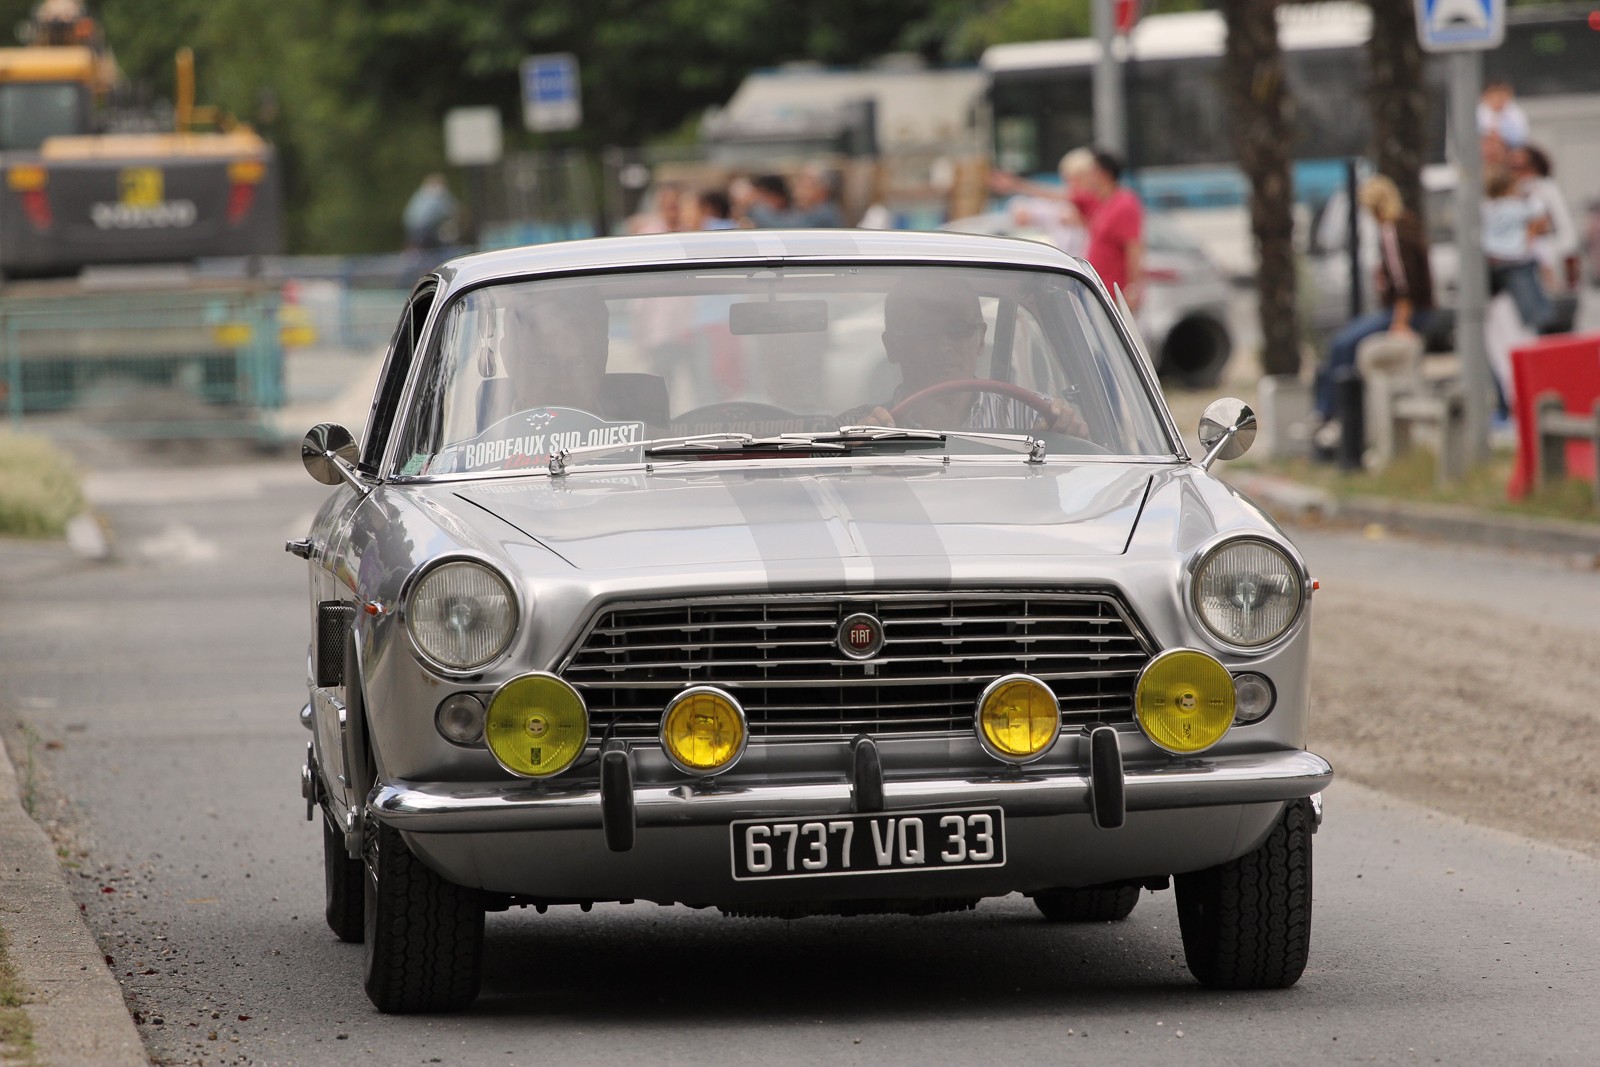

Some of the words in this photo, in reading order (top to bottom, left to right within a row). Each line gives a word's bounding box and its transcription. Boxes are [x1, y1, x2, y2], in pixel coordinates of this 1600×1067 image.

[465, 434, 545, 470] BORDEAUX
[549, 424, 639, 453] SUD-OUEST
[851, 629, 870, 643] FIAT
[745, 821, 854, 873] 6737
[870, 818, 925, 866] VQ
[940, 814, 994, 863] 33
